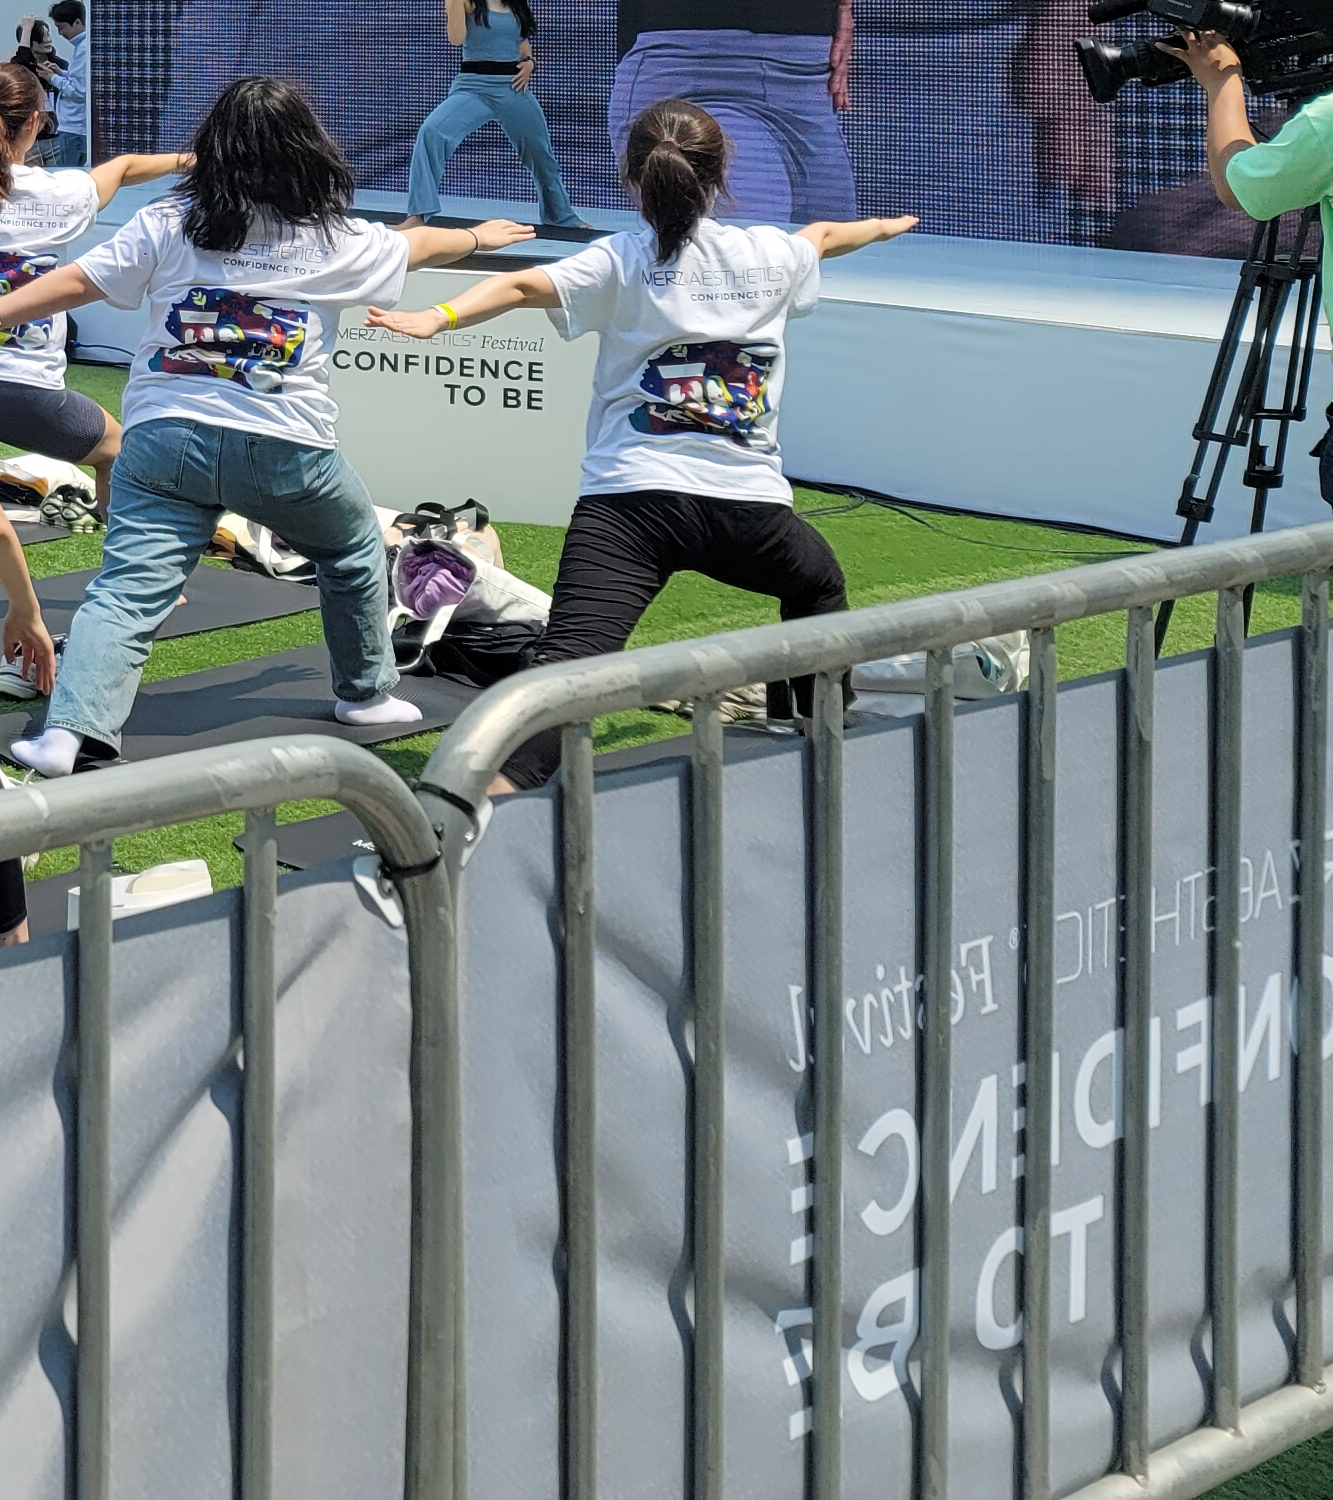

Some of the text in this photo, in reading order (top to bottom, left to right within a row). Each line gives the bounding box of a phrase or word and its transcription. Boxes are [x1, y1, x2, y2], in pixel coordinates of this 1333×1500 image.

[59, 221, 69, 229] BE
[222, 257, 290, 272] CONFIDENCE
[293, 264, 306, 274] TO
[642, 266, 783, 286] MERZ AESTHETICS
[690, 290, 759, 301] CONFIDENCE
[762, 290, 772, 298] TO
[337, 328, 377, 342] MERZ
[480, 334, 545, 352] Festival
[332, 349, 544, 383] CONFIDENCE
[443, 383, 544, 411] TO BE
